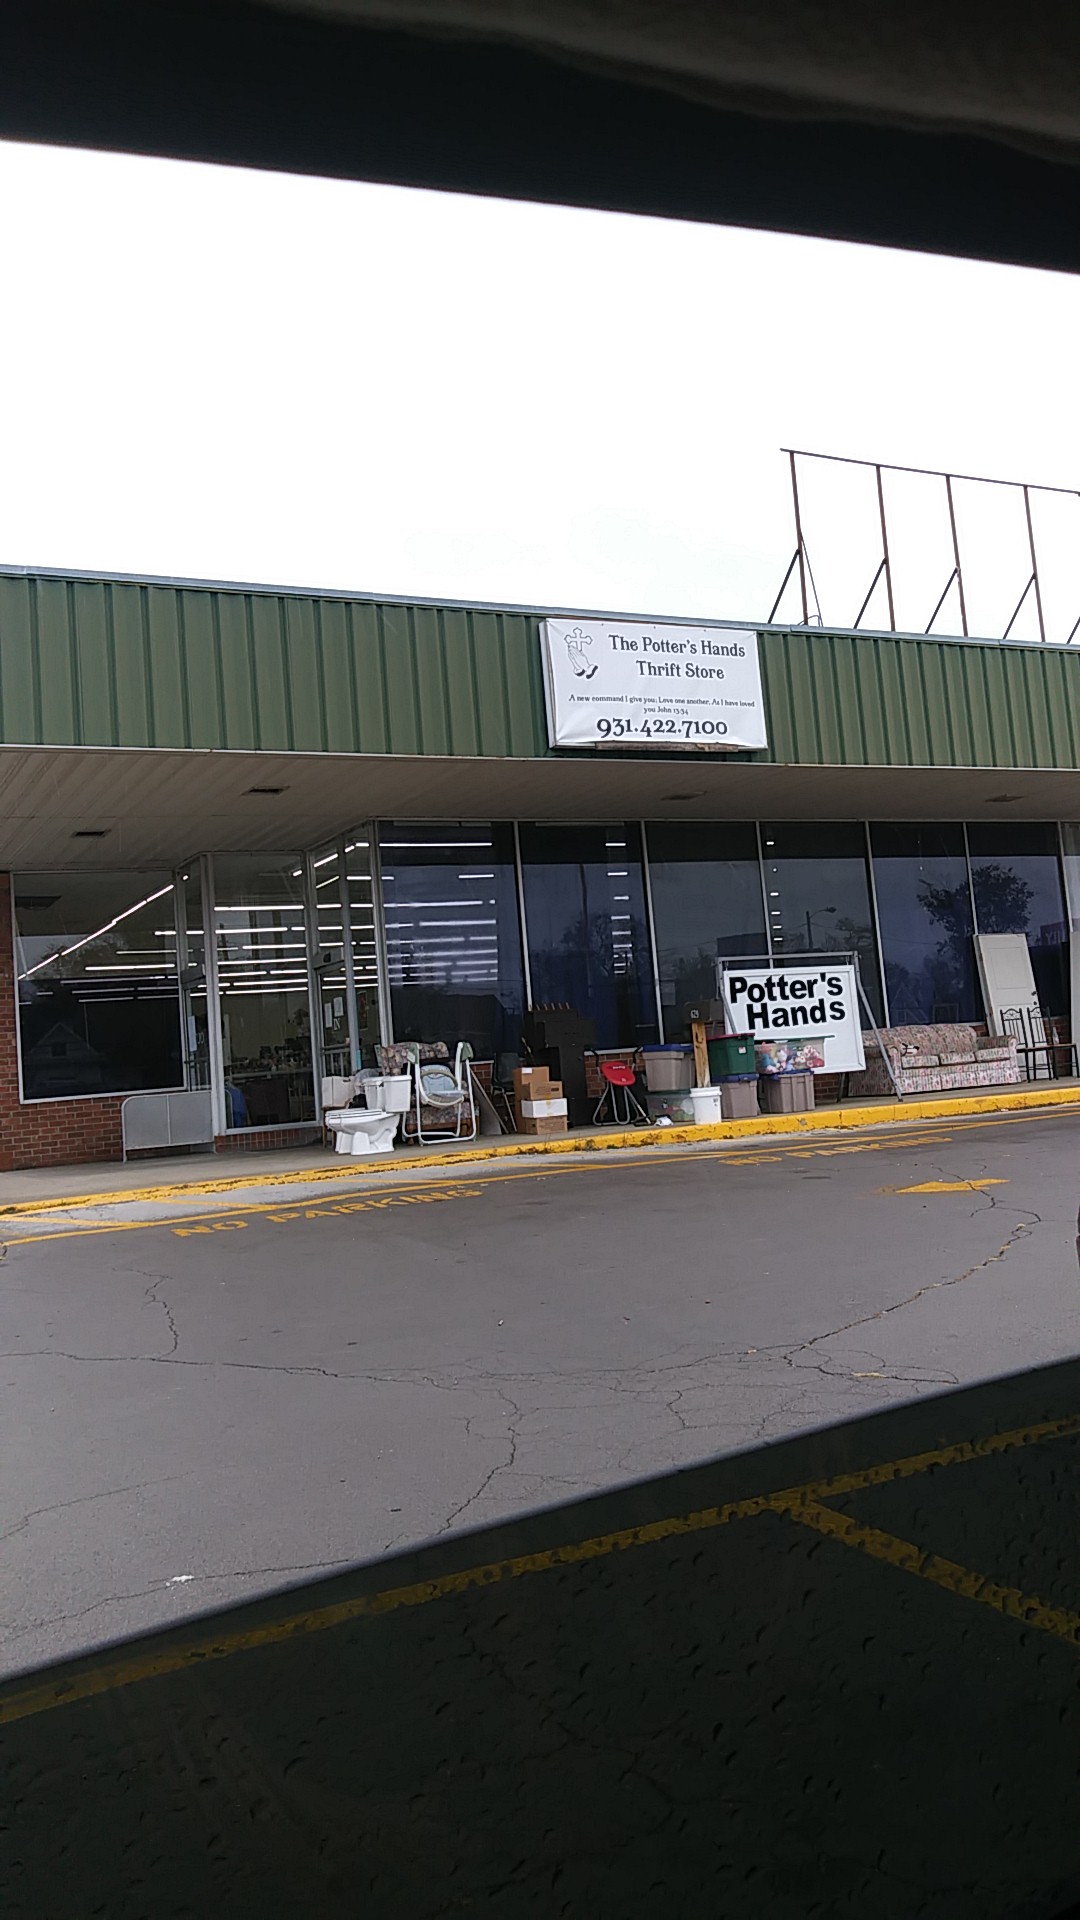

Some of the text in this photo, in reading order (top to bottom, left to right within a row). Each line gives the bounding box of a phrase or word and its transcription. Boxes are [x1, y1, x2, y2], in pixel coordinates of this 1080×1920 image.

[608, 634, 746, 657] The Potter's Hands
[636, 660, 725, 680] Thrift Store
[568, 693, 576, 702] A
[629, 696, 643, 704] give
[658, 696, 673, 704] Love
[711, 698, 720, 706] As
[596, 717, 728, 738] 931.422.7100
[729, 972, 843, 1004] Potter's
[746, 998, 846, 1030] Hands
[171, 1188, 483, 1237] NO PARKING
